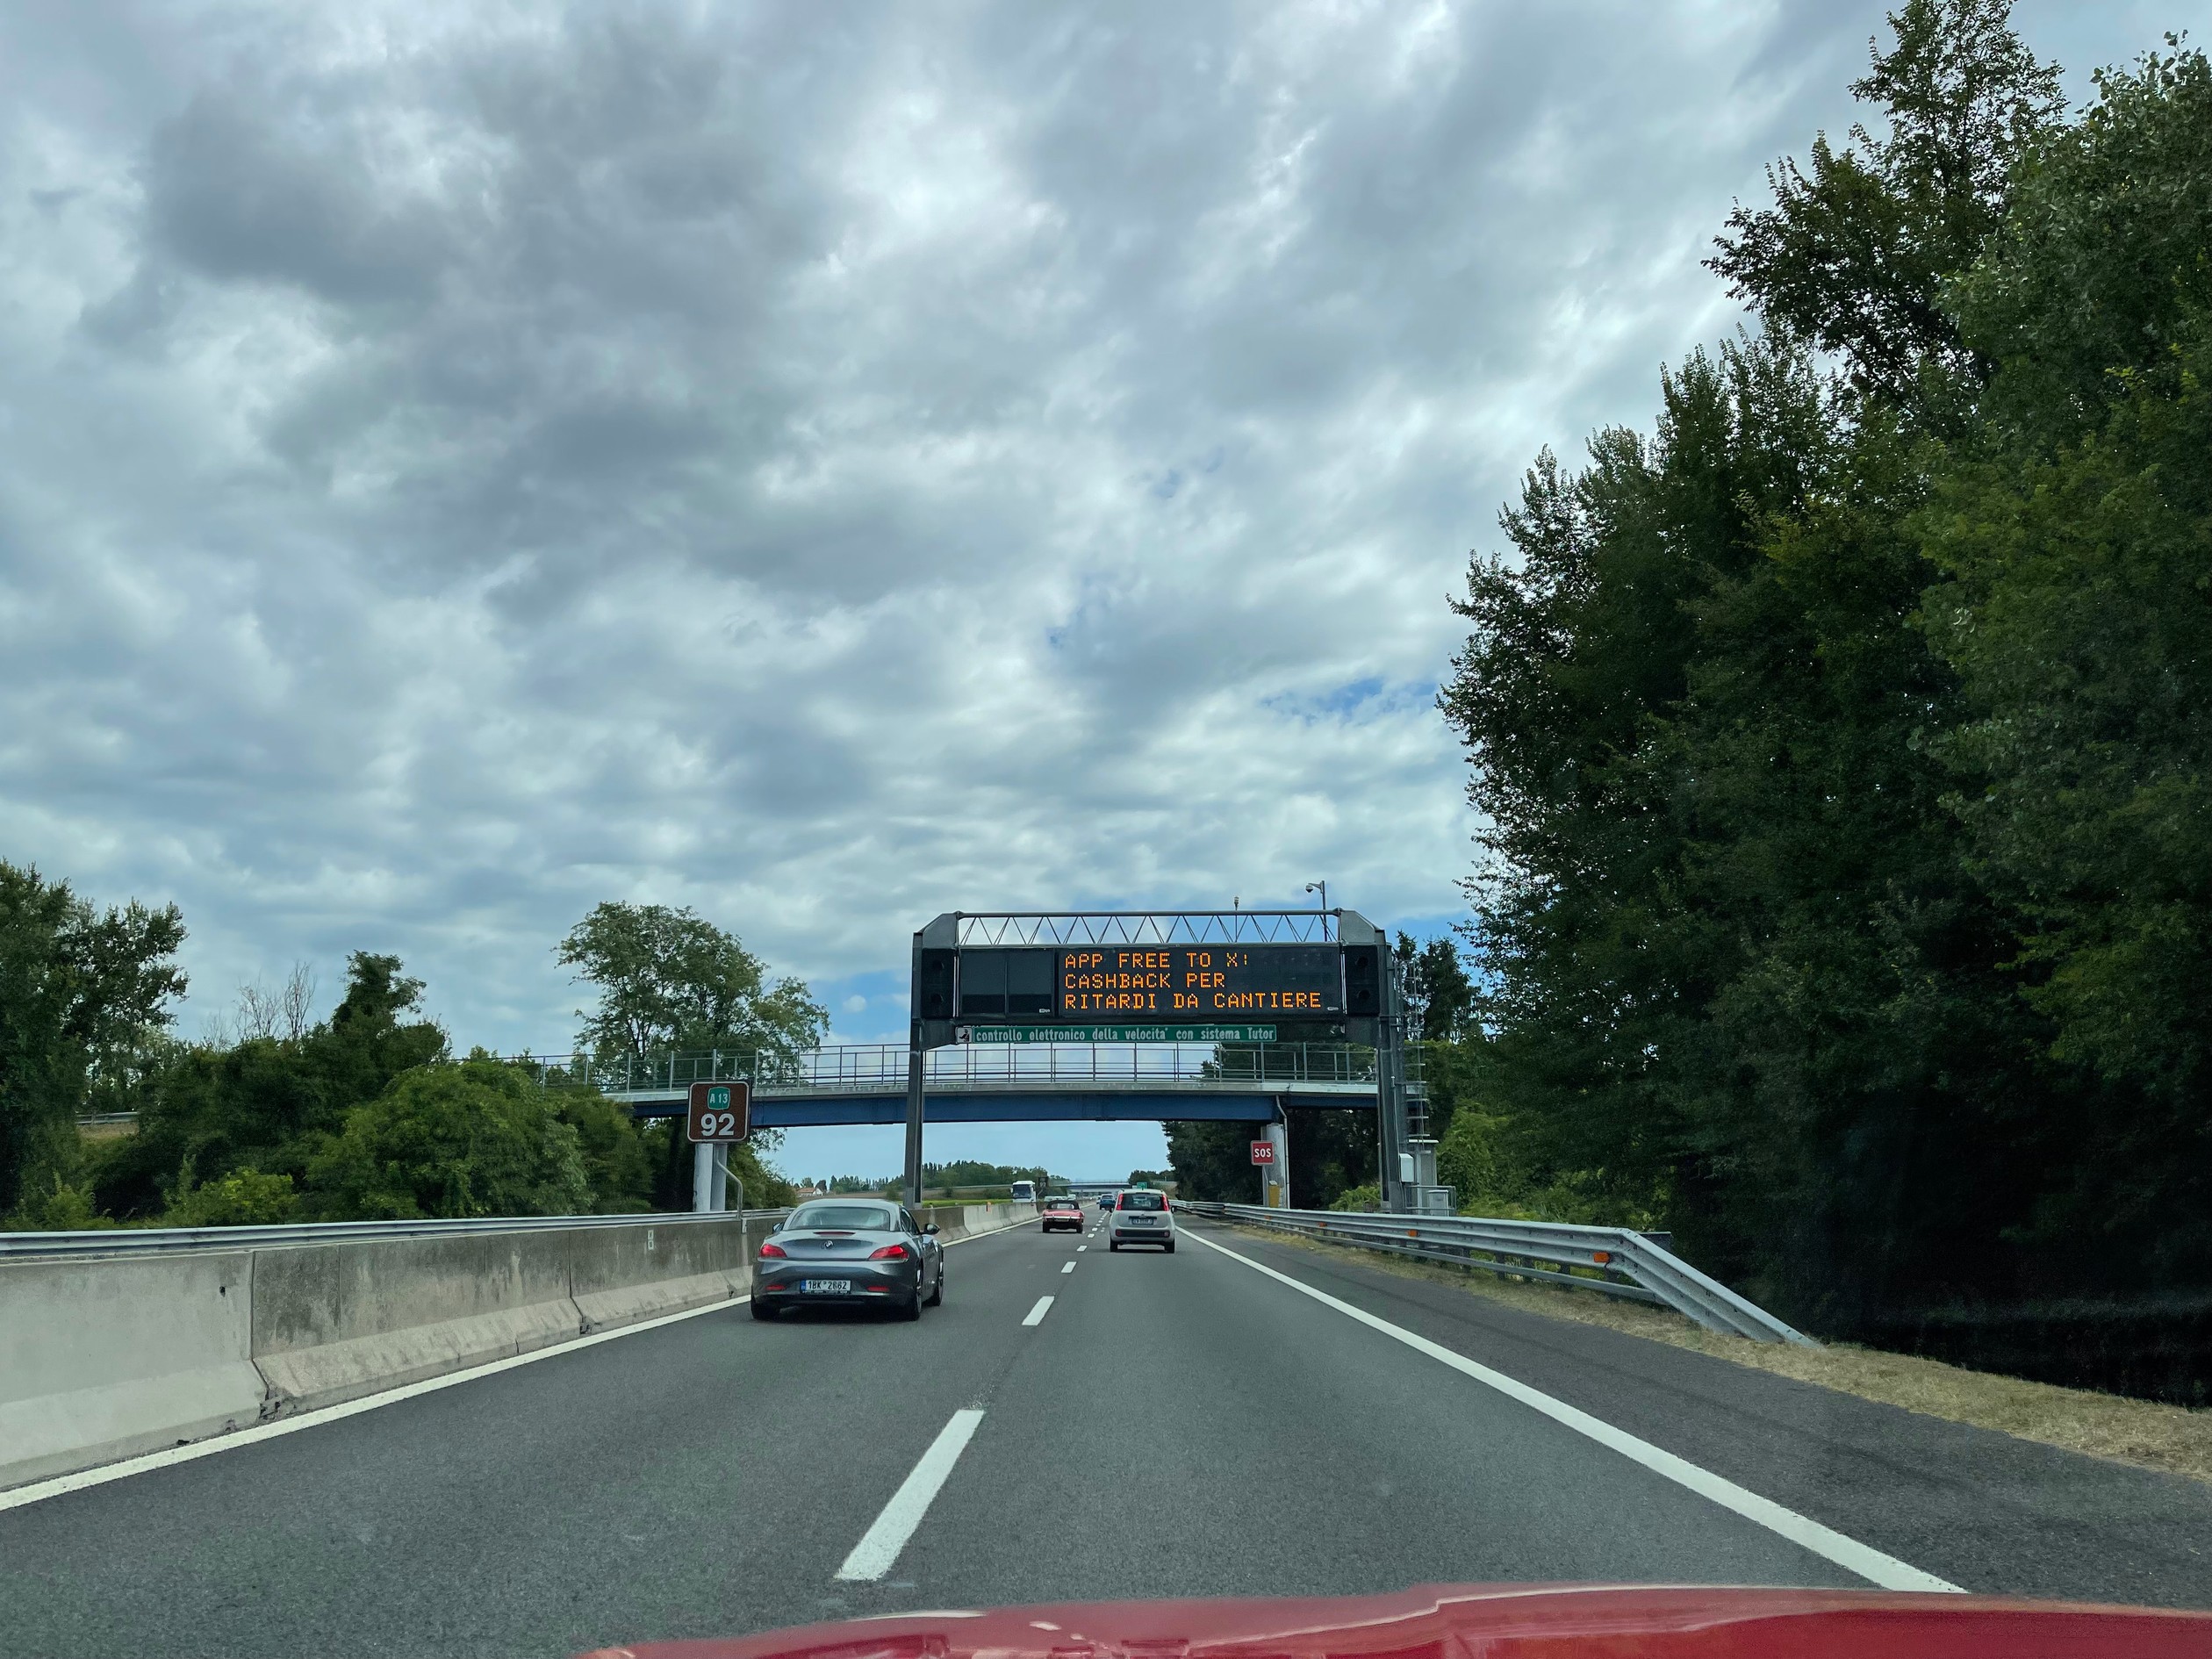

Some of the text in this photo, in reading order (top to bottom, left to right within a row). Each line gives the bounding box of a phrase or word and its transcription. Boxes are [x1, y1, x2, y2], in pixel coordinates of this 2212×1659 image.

[1065, 952, 1102, 968] APP
[1118, 952, 1170, 968] FREE
[1186, 952, 1211, 967] TO
[1065, 972, 1225, 988] CASHBACK PER
[1065, 992, 1321, 1009] RITARDI DA CANTIERE
[976, 1031, 1023, 1042] controllo
[1029, 1030, 1085, 1041] elettronico
[1092, 1028, 1118, 1040] della
[1175, 1030, 1194, 1040] con
[1200, 1027, 1240, 1040] sistema
[1246, 1027, 1274, 1040] Tutor
[700, 1113, 735, 1137] 92
[1254, 1148, 1272, 1158] SOS
